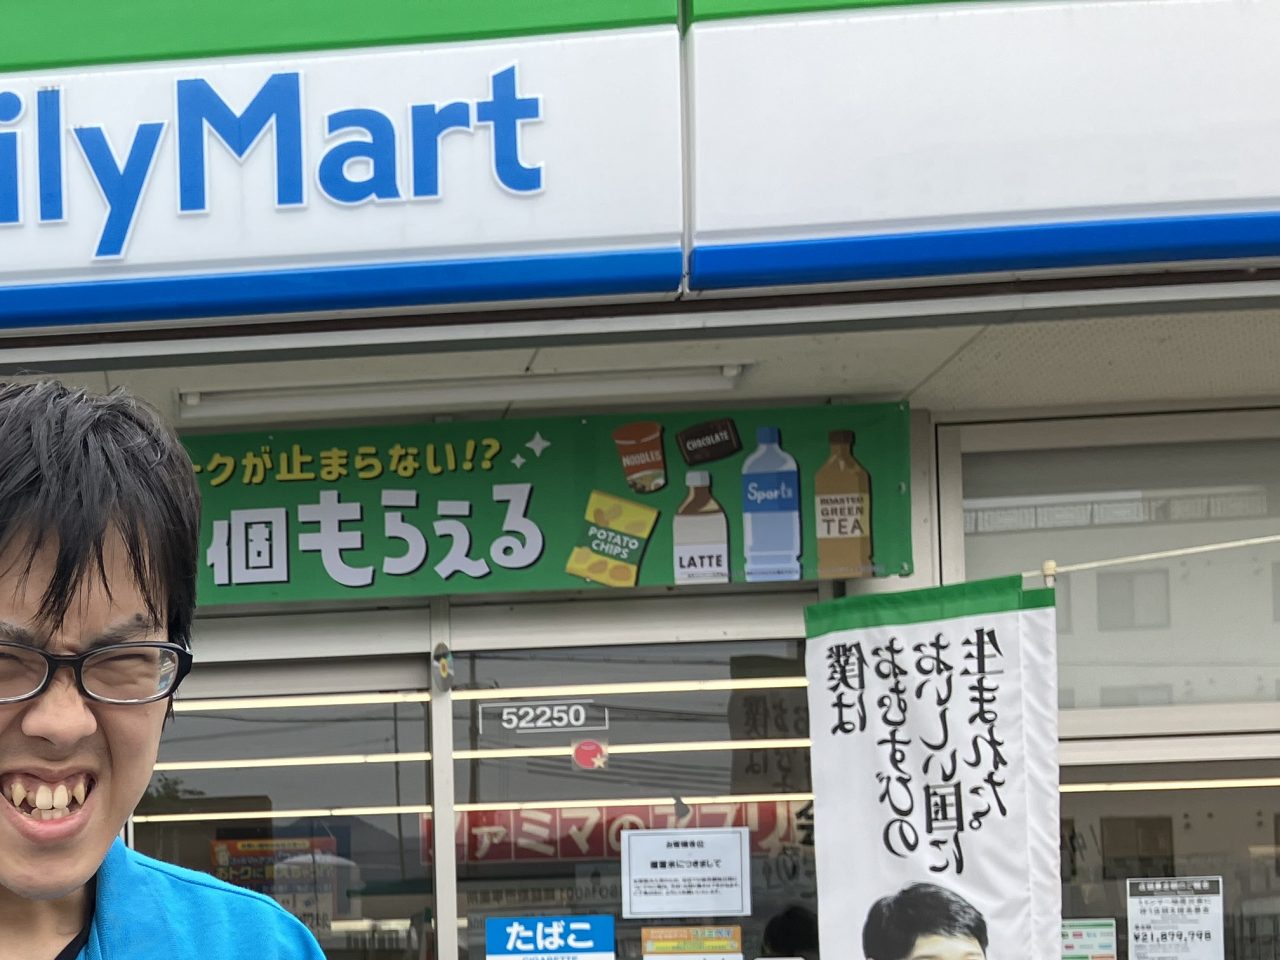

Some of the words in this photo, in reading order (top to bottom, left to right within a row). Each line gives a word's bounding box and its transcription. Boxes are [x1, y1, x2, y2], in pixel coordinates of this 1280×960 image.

[685, 430, 729, 451] CHOCOLATE
[194, 438, 500, 486] クが止まらない!?
[622, 451, 662, 467] NOODLES
[747, 482, 793, 504] Sports
[821, 506, 864, 516] GREEN
[207, 483, 544, 587] 個もらえる
[822, 518, 864, 535] TEA
[588, 526, 639, 550] POTATO
[591, 540, 629, 559] CHIPS
[679, 554, 723, 569] LATTE
[501, 704, 586, 729] 52250
[505, 919, 594, 951] たばこ
